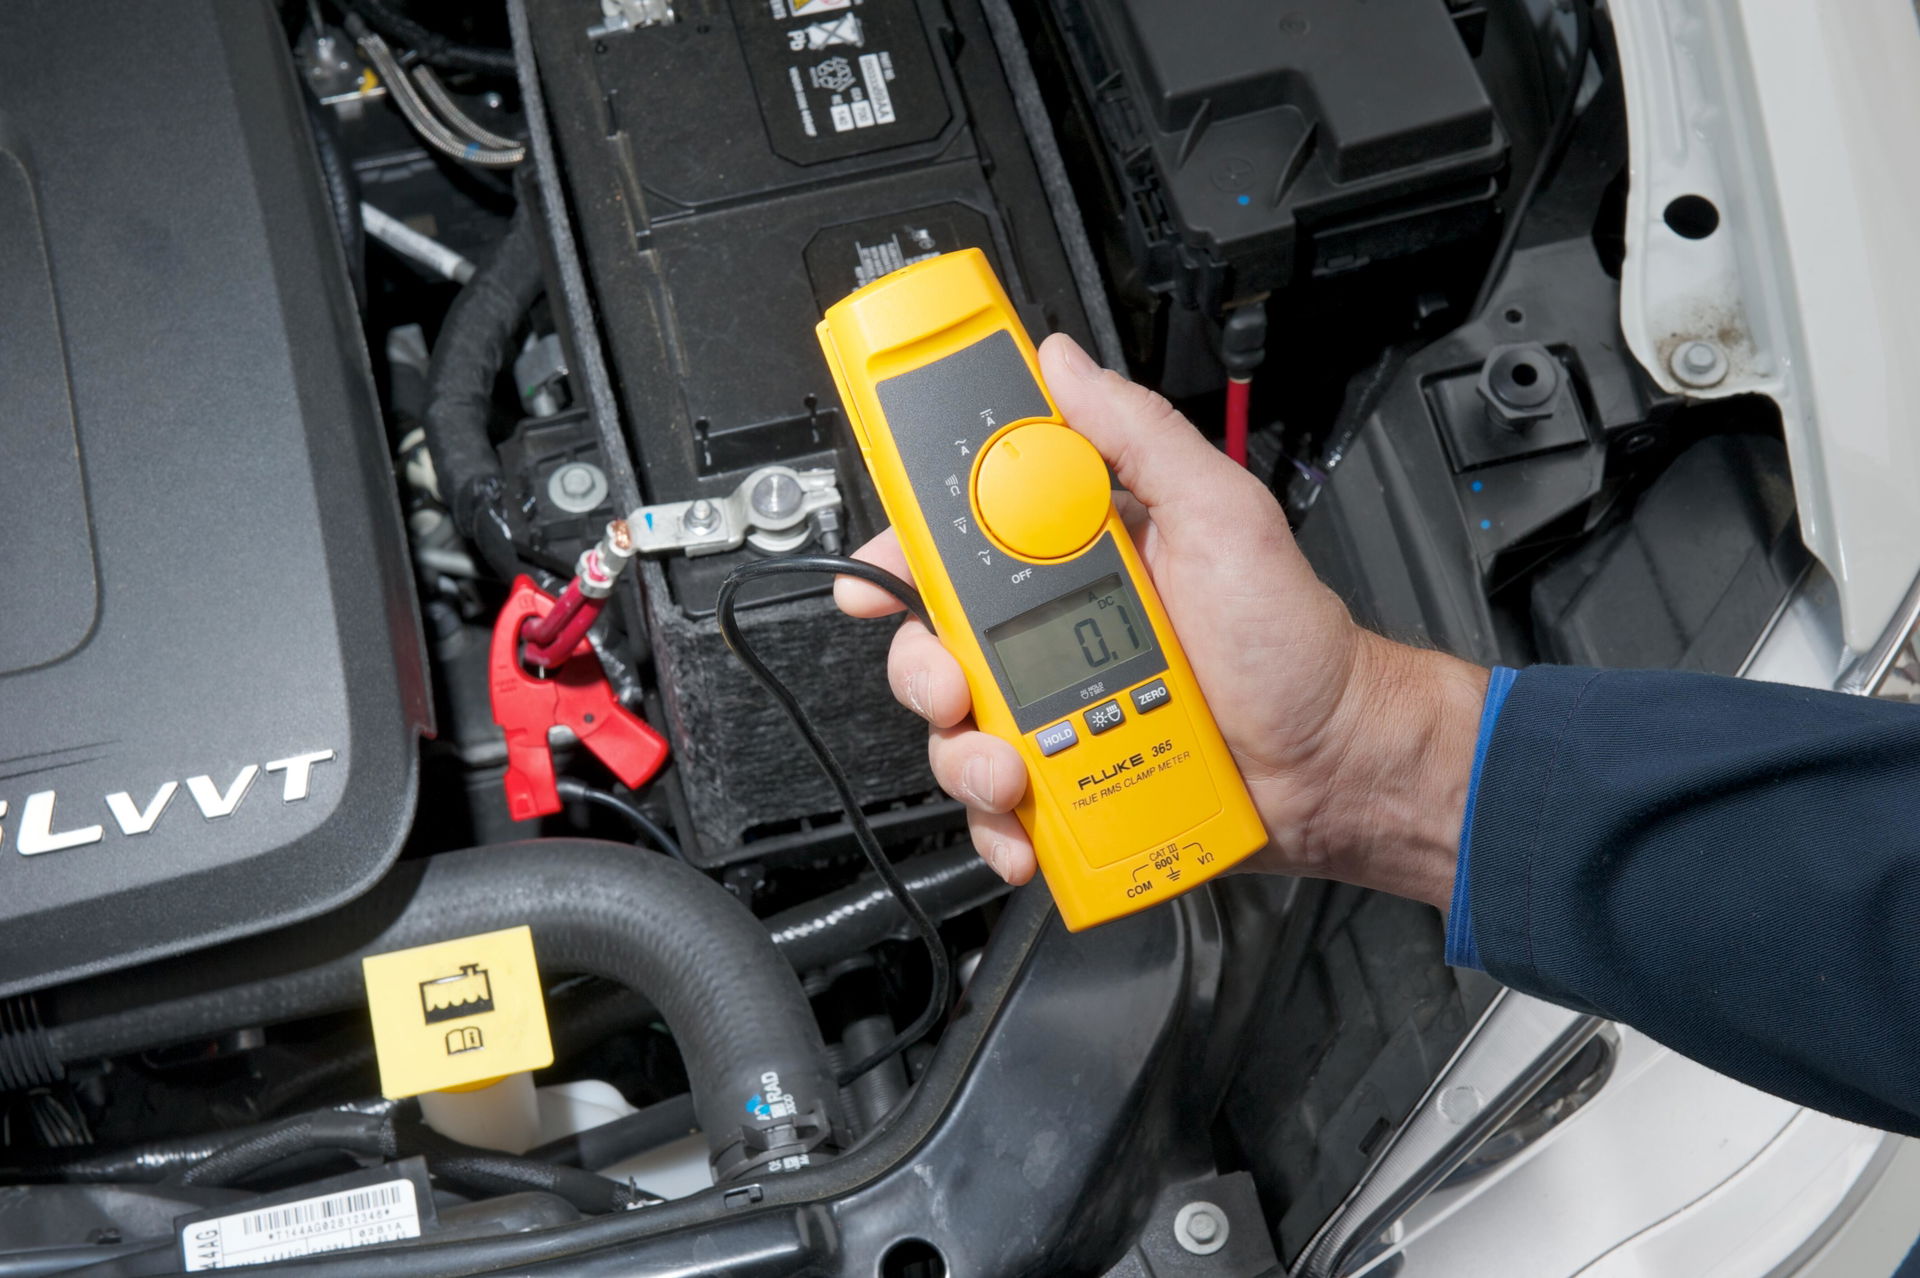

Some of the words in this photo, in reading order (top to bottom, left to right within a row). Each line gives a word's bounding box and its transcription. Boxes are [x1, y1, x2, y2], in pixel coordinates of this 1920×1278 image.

[787, 29, 806, 51] Pb
[1011, 568, 1033, 584] OFF
[1097, 596, 1114, 609] DC
[1073, 605, 1140, 668] 0.1
[1138, 686, 1167, 706] ZERO
[1043, 728, 1073, 747] HOLD
[1077, 753, 1145, 790] FLUKE
[1151, 739, 1173, 758] 365
[1072, 793, 1099, 811] TRUE
[1100, 783, 1122, 800] RMS
[1123, 766, 1157, 790] CLAMP
[1158, 751, 1191, 774] METER
[1149, 846, 1167, 862] CAT
[1126, 880, 1153, 899] COM
[761, 1071, 782, 1103] RAD
